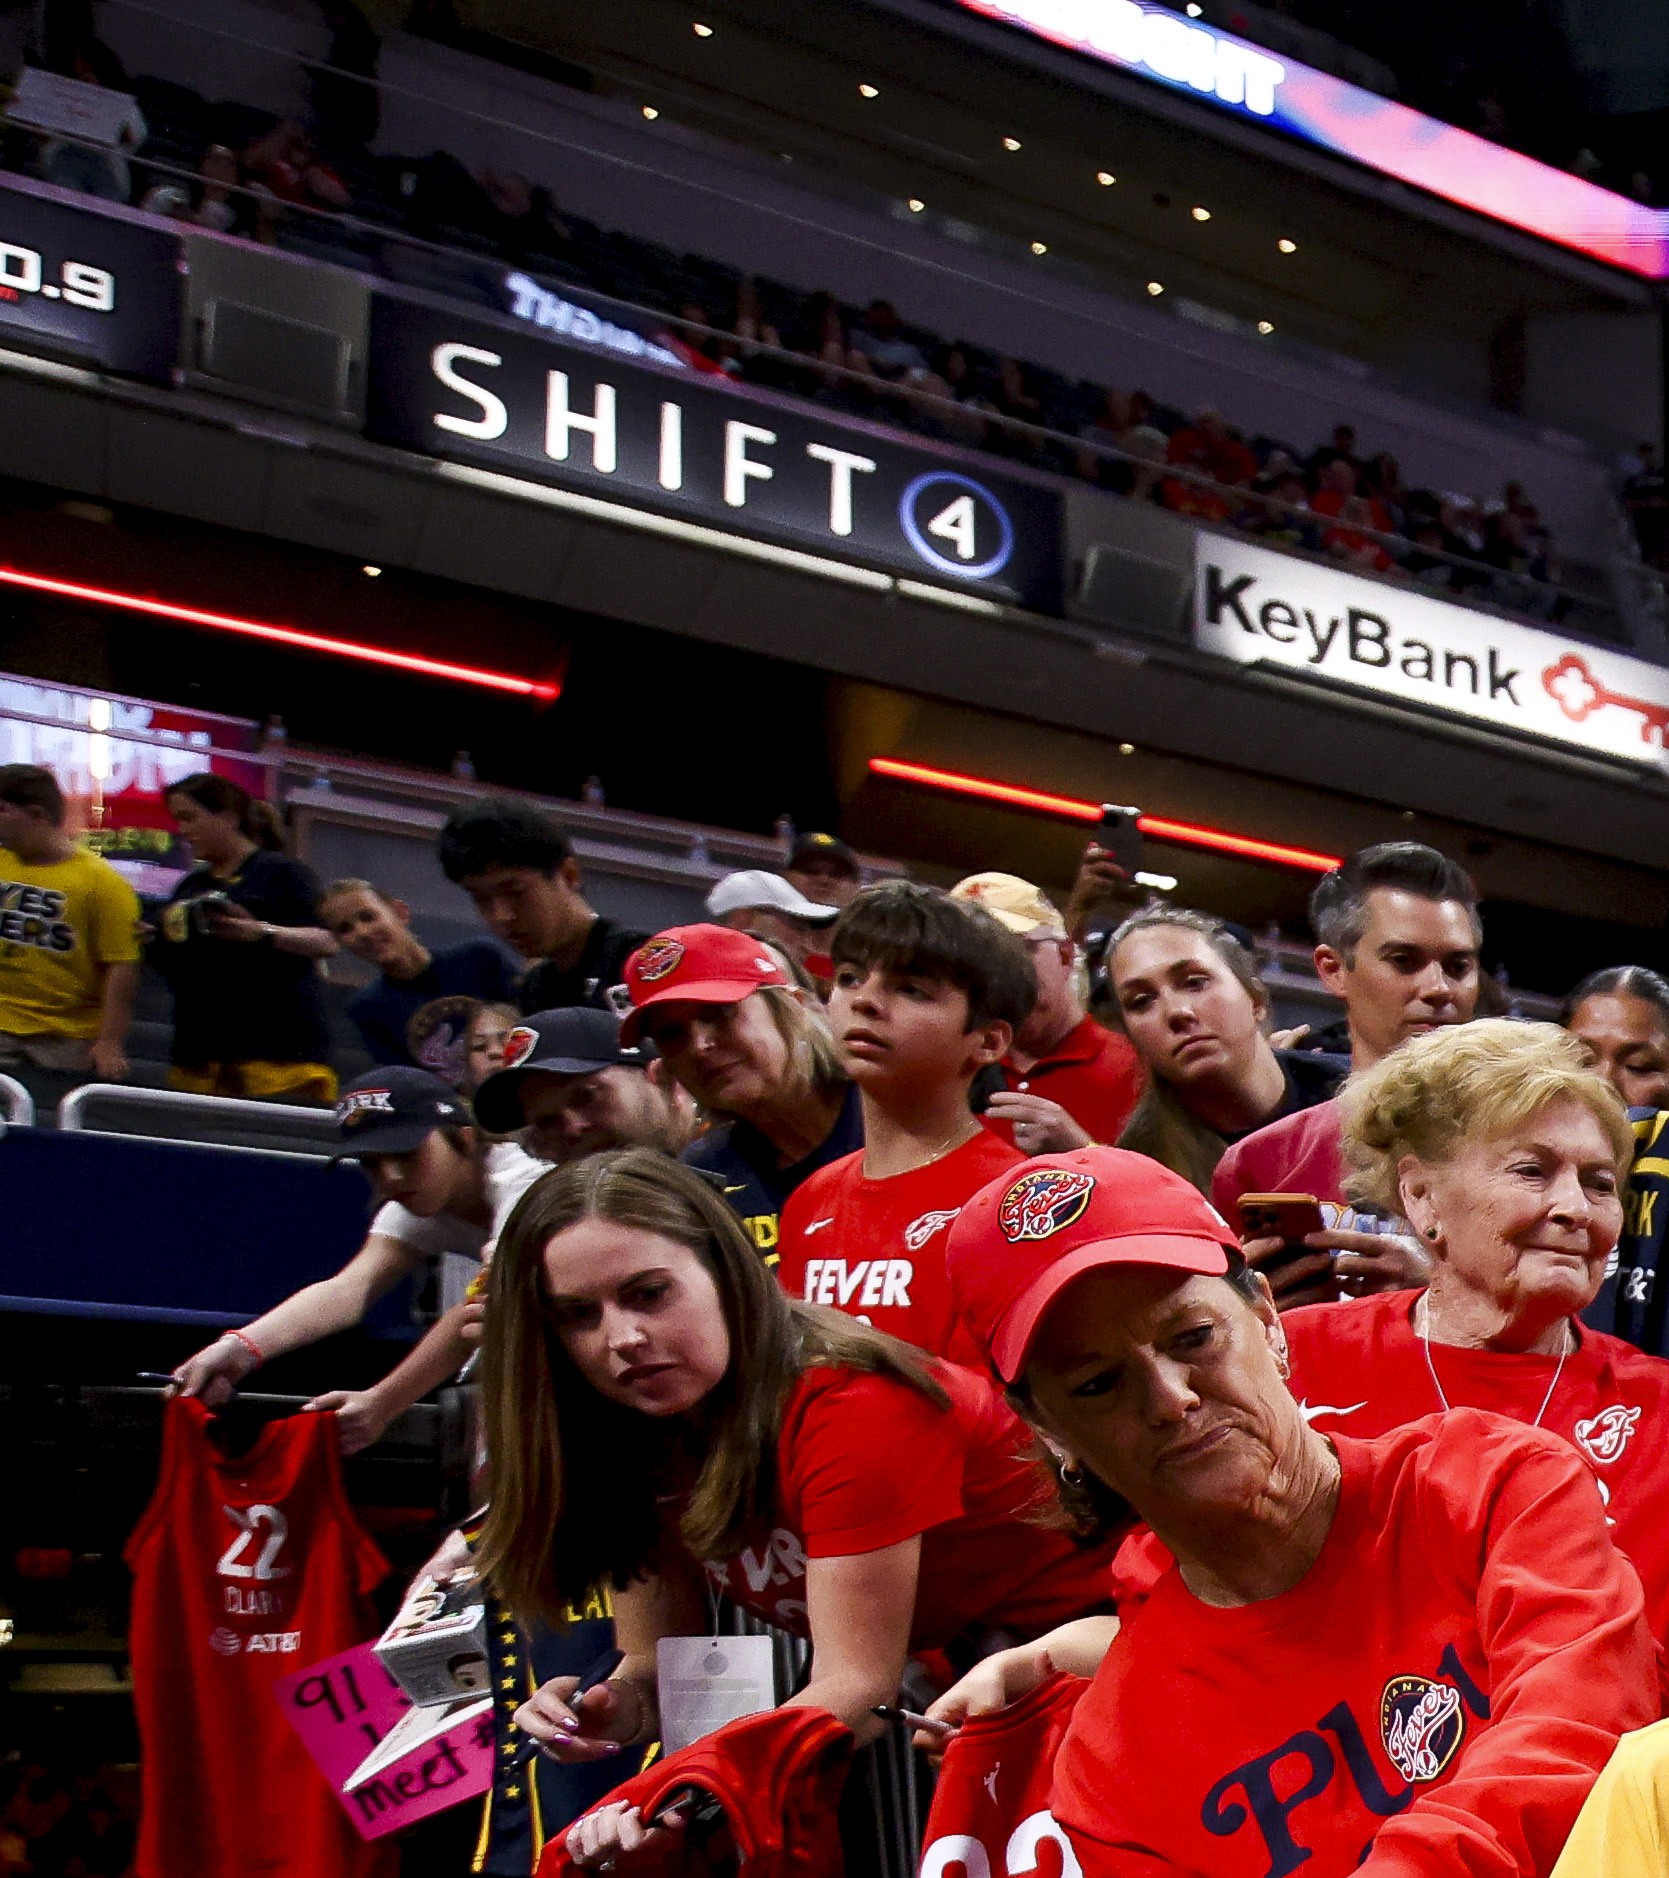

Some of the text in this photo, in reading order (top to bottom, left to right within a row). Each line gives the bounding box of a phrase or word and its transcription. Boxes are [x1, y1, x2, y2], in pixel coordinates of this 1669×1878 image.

[431, 341, 978, 559] SHIFT 4
[1204, 565, 1523, 707] KeyBank
[804, 1259, 913, 1307] FEVER
[216, 1504, 292, 1580] 22
